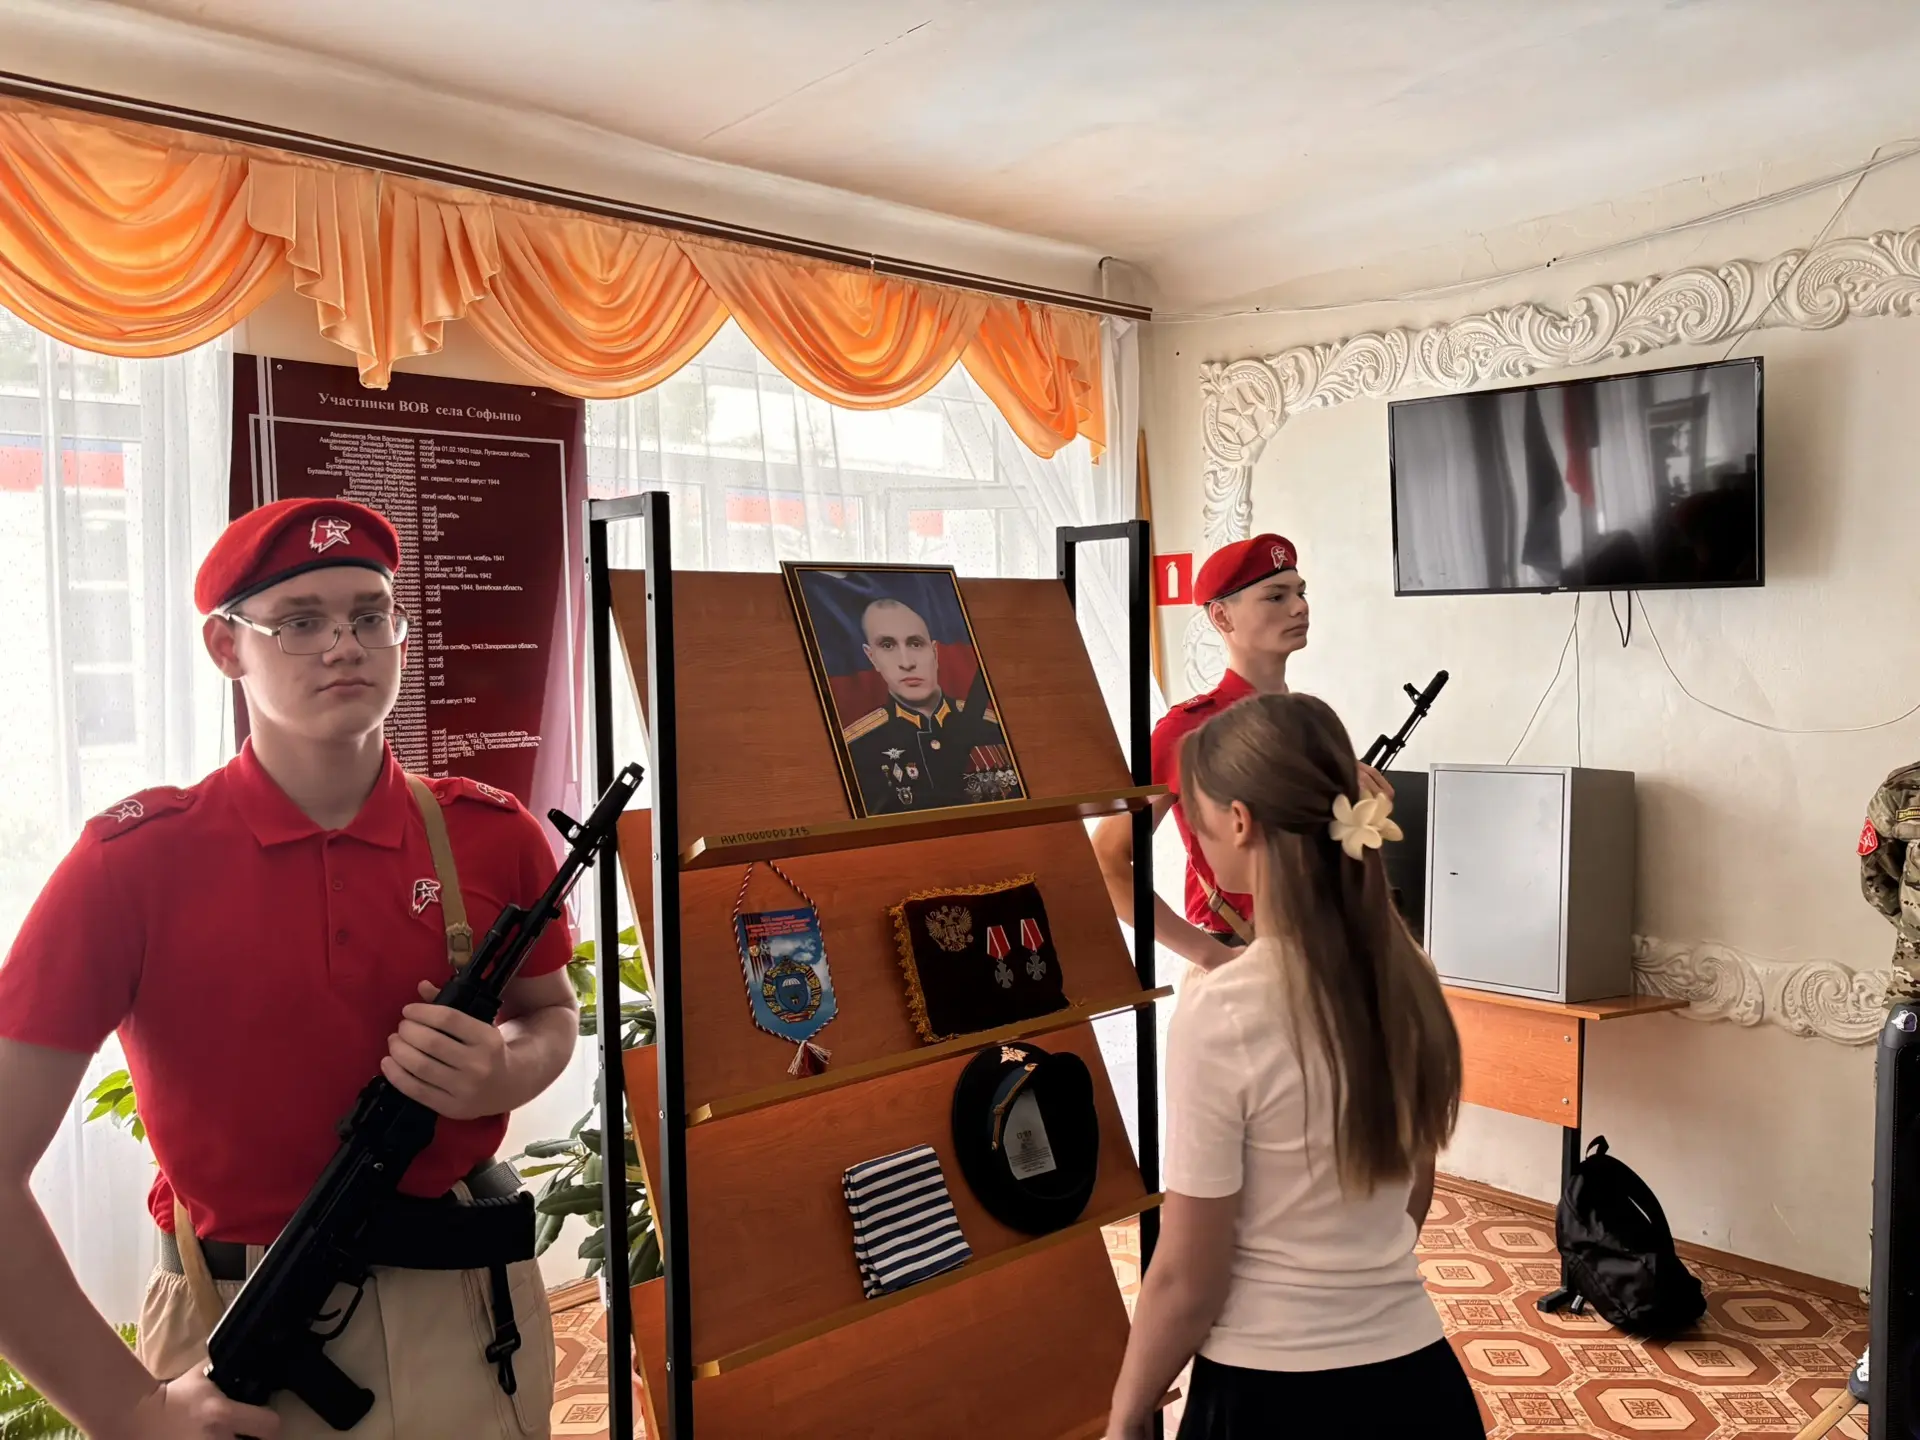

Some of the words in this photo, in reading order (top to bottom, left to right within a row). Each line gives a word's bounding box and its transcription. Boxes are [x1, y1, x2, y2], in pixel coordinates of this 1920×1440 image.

[318, 392, 394, 410] Участники
[399, 400, 429, 414] ВОВ
[436, 406, 464, 417] села
[466, 406, 521, 422] Софьино
[382, 435, 414, 443] Васильевич
[359, 446, 387, 455] Владимир
[388, 448, 415, 456] Петрович
[360, 440, 384, 448] Зинаида
[385, 442, 414, 450] Яковлевна
[484, 449, 509, 457] Луганская
[385, 460, 415, 468] Федорович
[345, 470, 374, 478] Владимир
[375, 472, 416, 480] Митрофанович
[385, 466, 416, 474] Федорович
